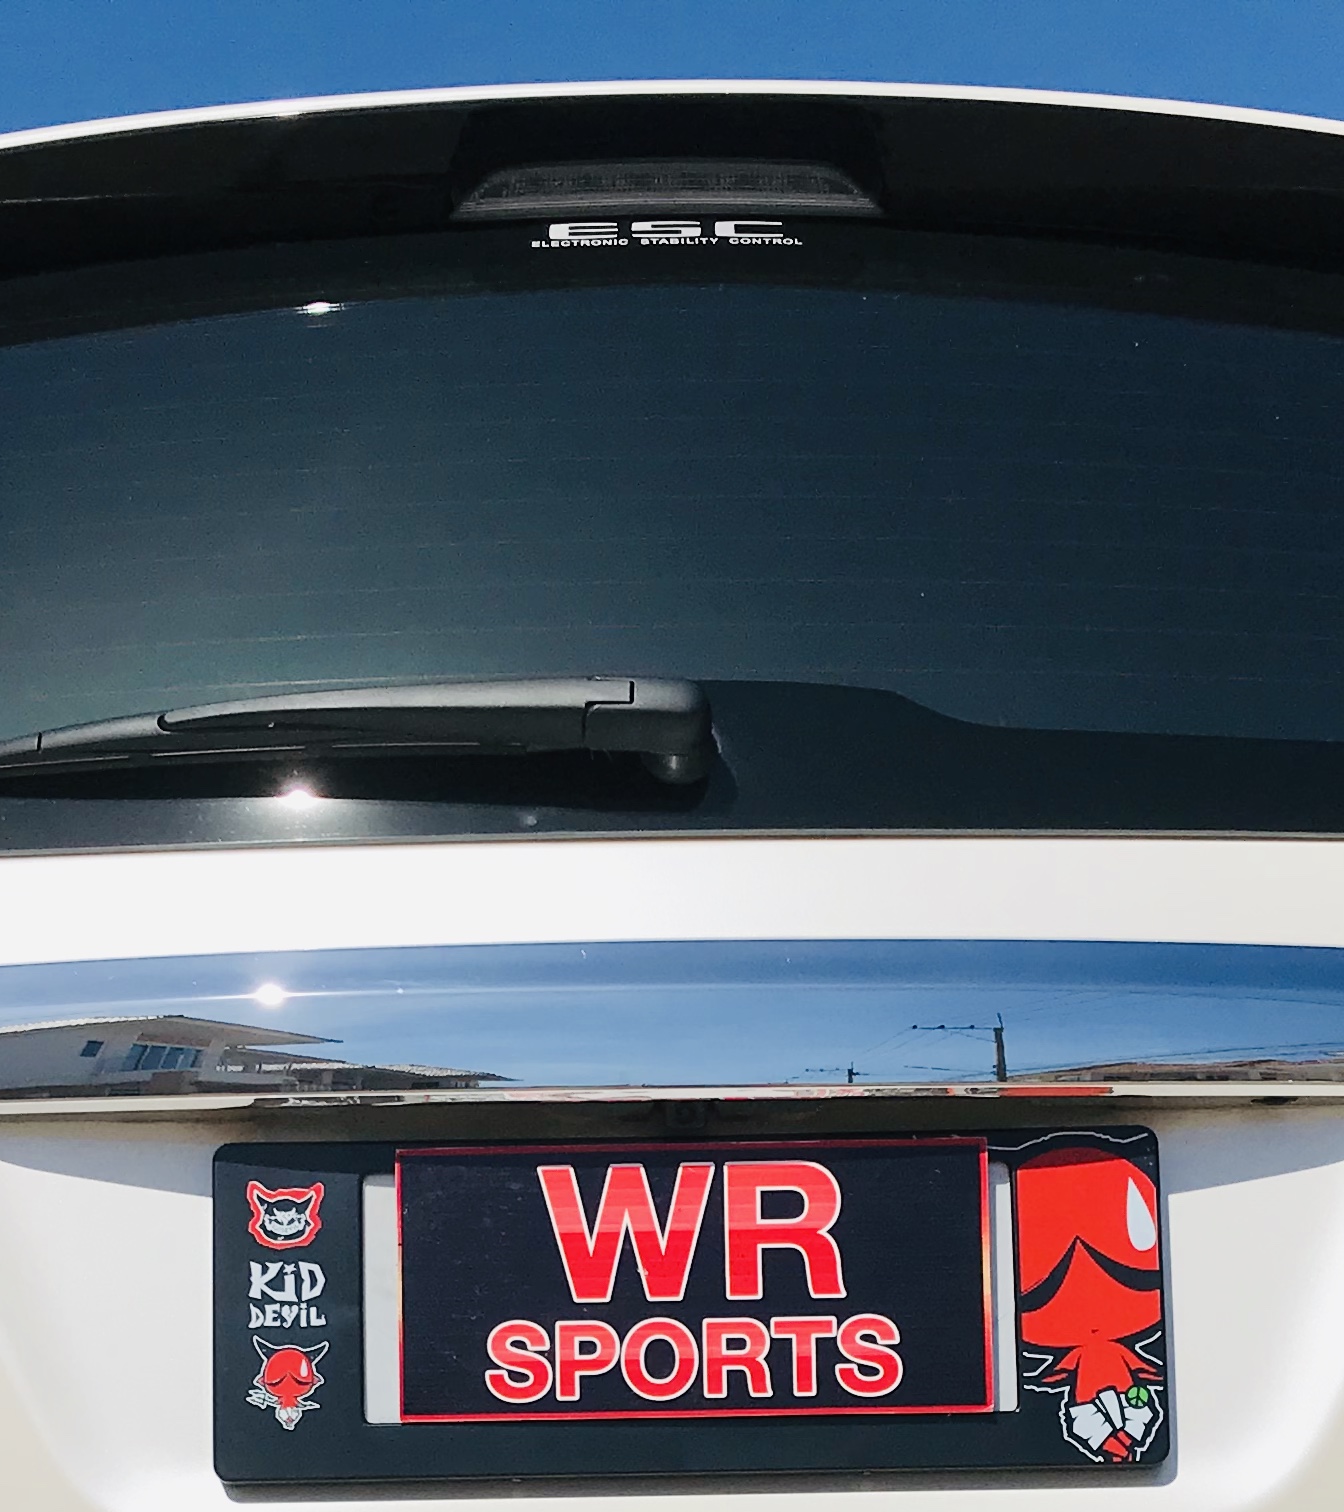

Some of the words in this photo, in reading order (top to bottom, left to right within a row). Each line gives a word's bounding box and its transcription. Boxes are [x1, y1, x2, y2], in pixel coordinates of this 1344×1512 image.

[531, 239, 629, 248] ELECTRONIC
[640, 237, 719, 245] STABILITY
[728, 237, 803, 246] CONTROL
[549, 221, 784, 240] ESC
[537, 1160, 847, 1304] WR
[484, 1315, 904, 1401] SPORTS
